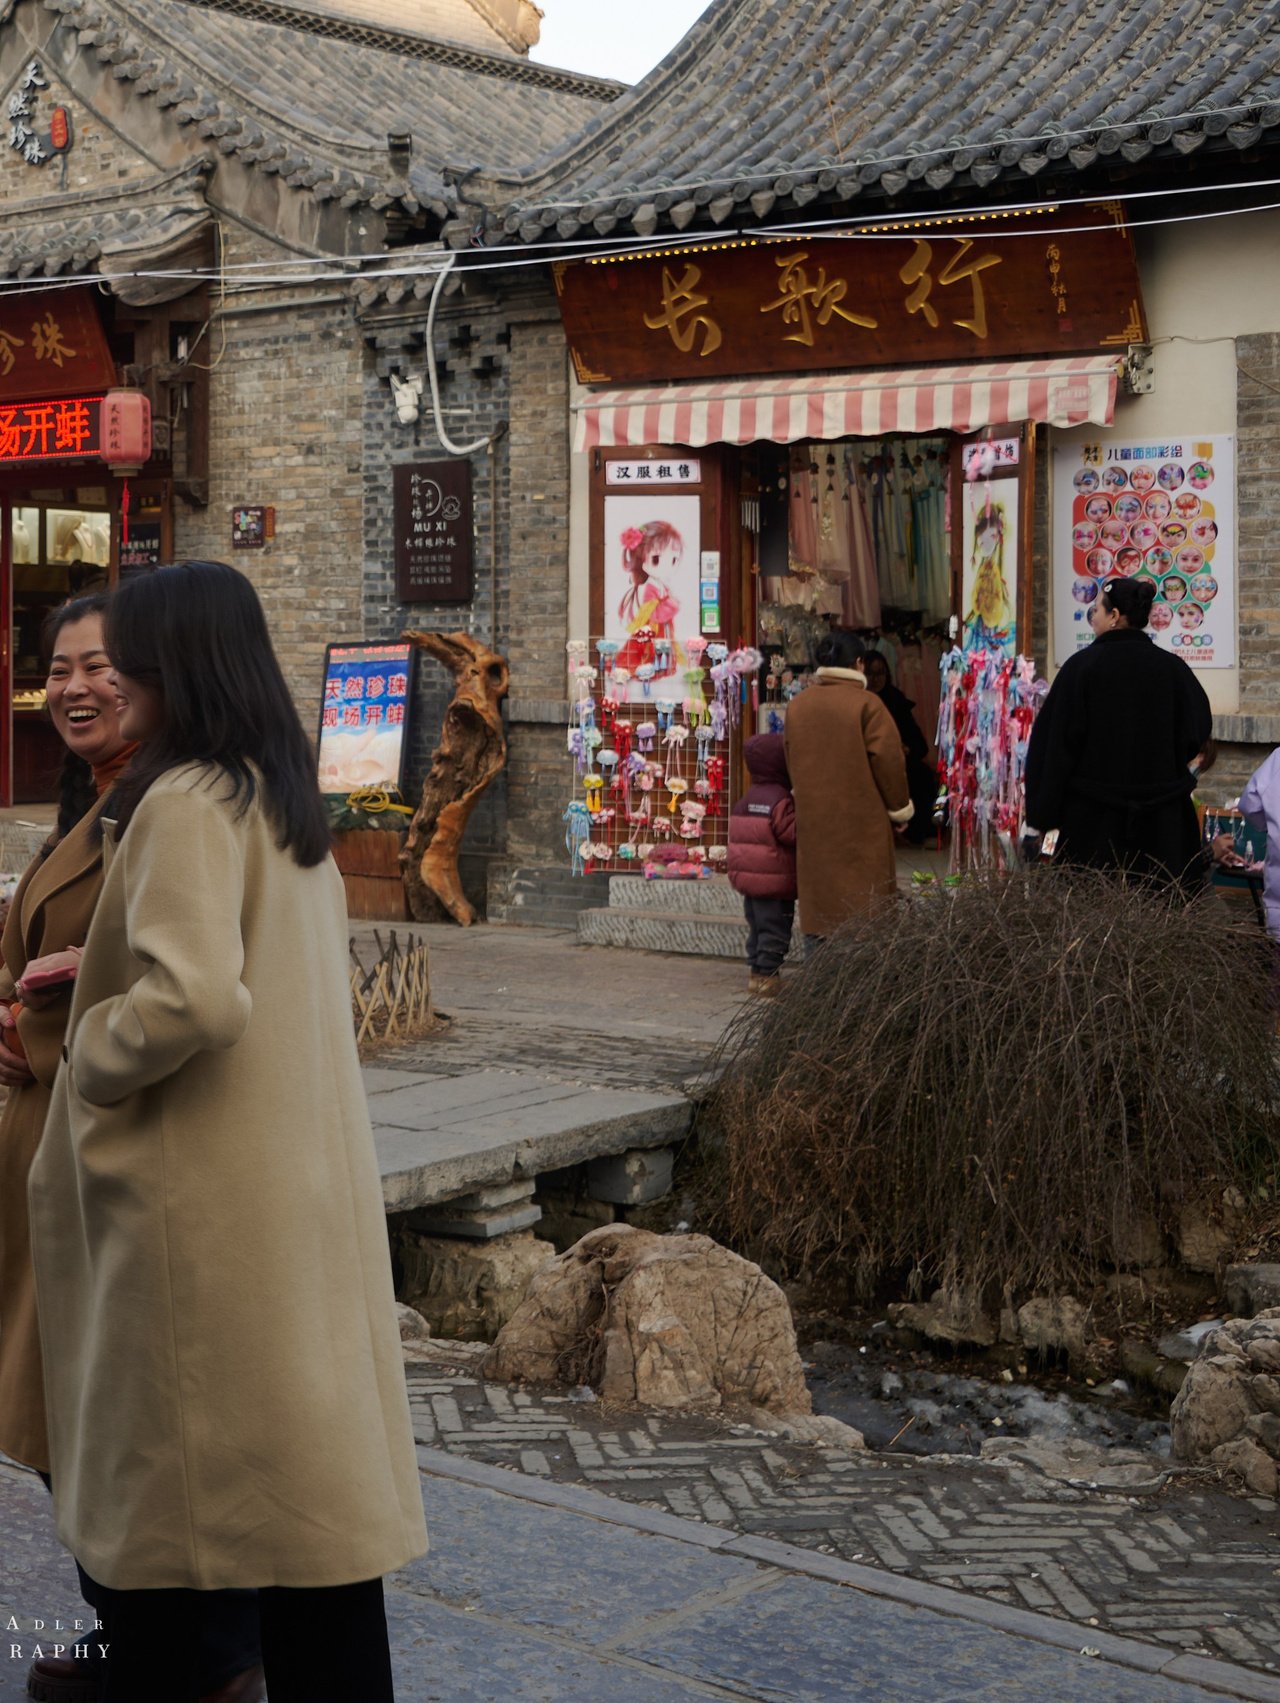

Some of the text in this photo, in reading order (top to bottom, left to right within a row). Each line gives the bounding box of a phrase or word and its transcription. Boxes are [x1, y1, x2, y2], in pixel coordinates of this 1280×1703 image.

[1046, 244, 1067, 314] 丙申秋月
[1107, 444, 1183, 461] 儿童面部彩绘
[616, 463, 690, 479] 汉服租售
[414, 521, 447, 532] MU XI
[325, 674, 407, 700] 天然珍珠
[322, 703, 405, 727] 现场开蚌
